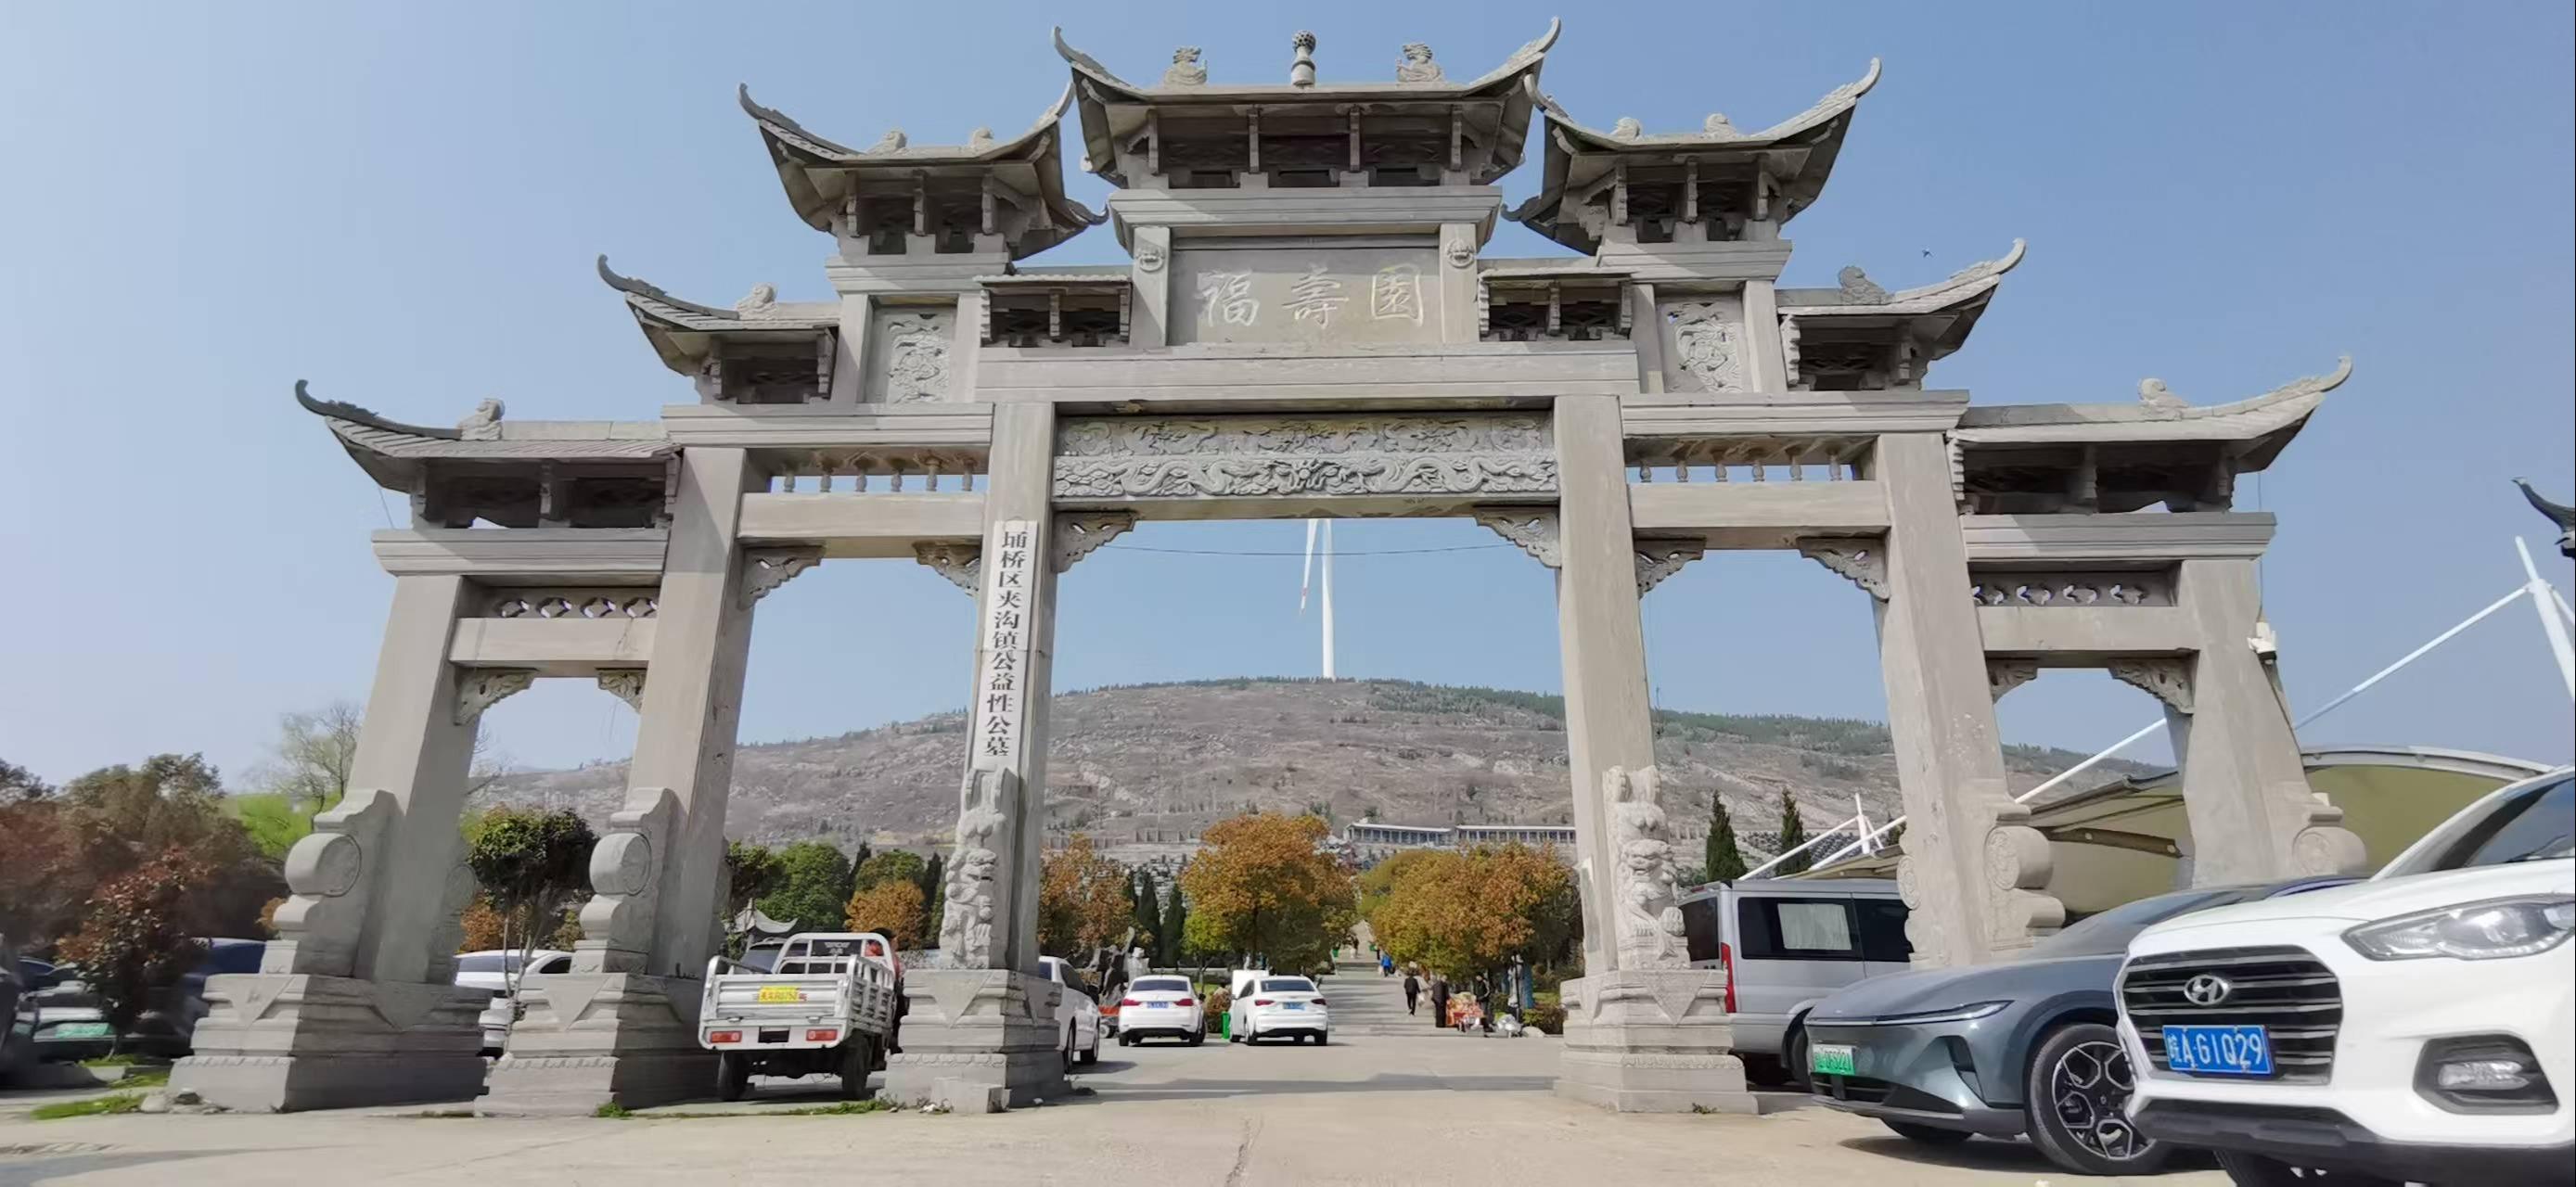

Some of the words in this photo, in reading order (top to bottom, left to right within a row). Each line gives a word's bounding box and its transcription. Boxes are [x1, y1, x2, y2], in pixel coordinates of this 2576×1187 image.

[984, 530, 1028, 757] 埇桥区夹沟镇公益性公墓
